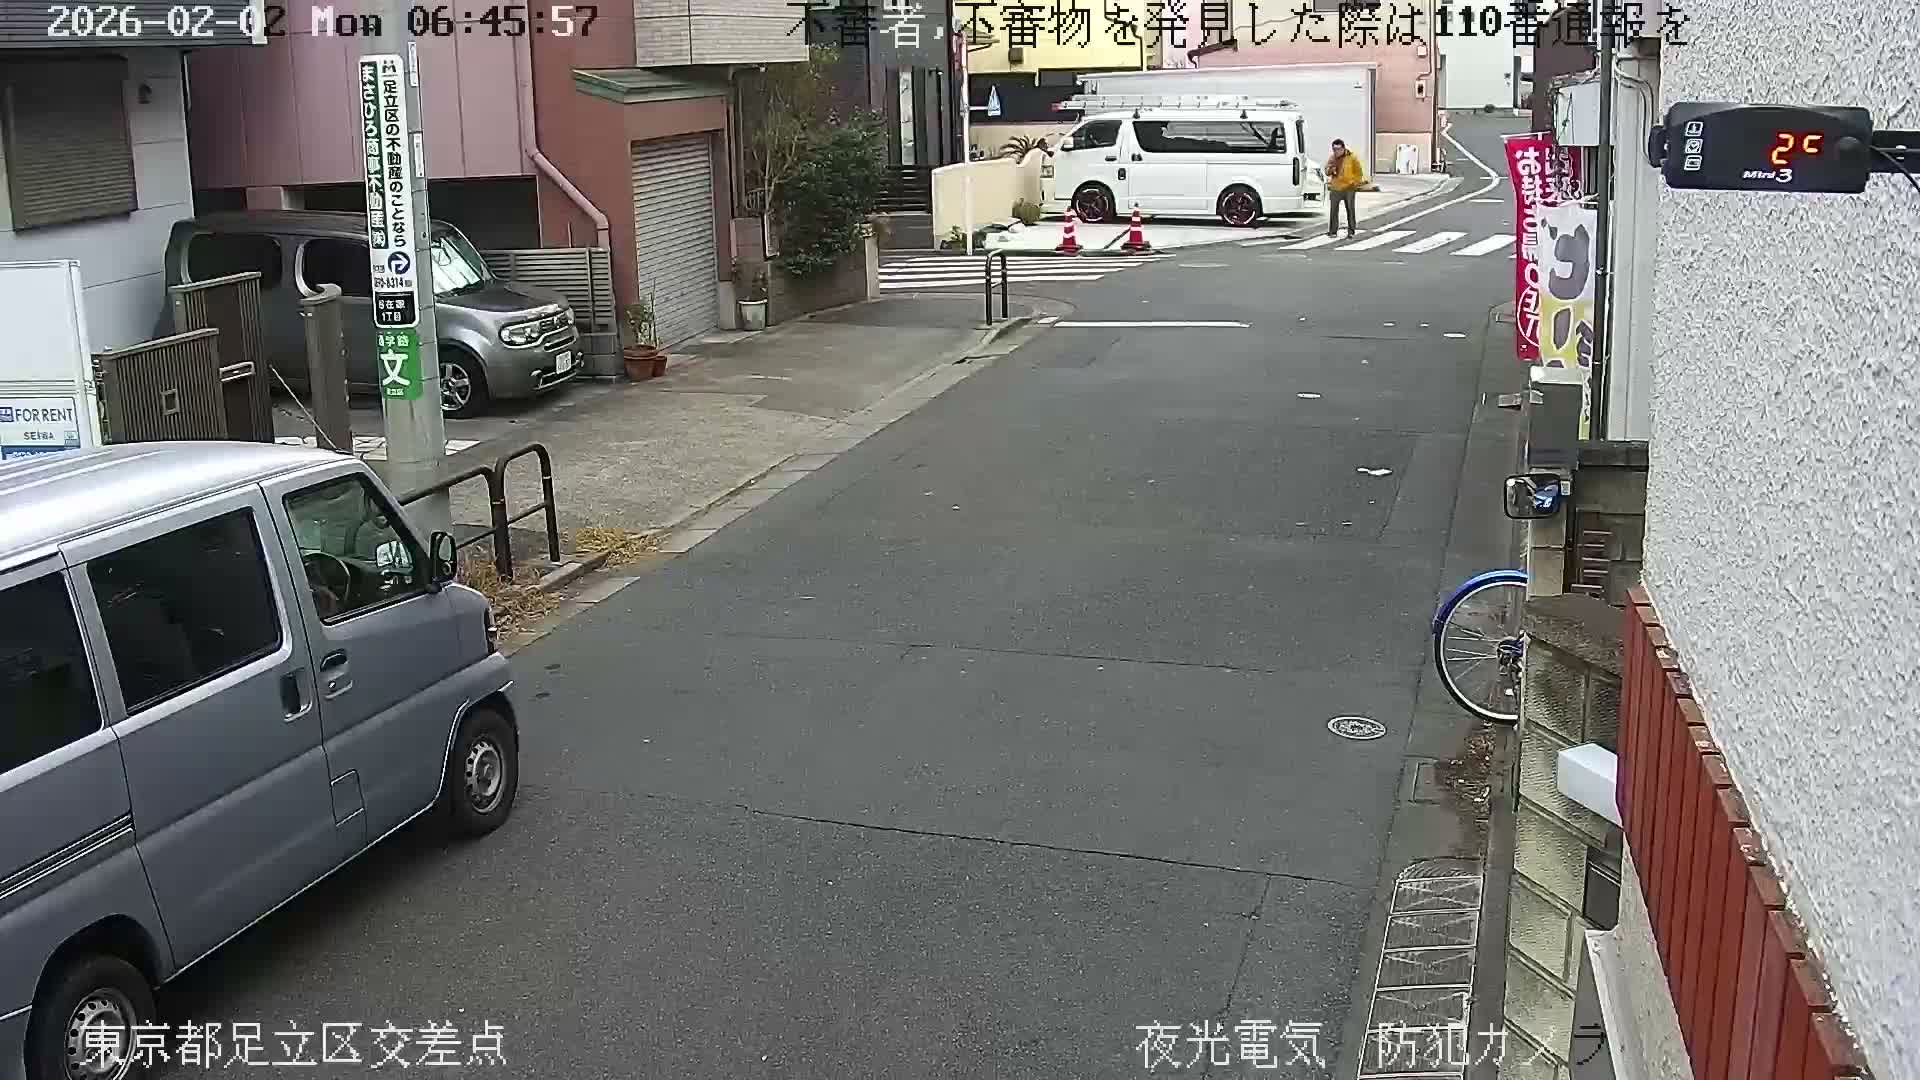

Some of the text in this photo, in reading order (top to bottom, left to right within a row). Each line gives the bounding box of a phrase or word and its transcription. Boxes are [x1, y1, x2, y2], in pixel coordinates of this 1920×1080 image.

[383, 79, 407, 247] 足立区の不動産のことなら
[380, 348, 411, 386] 文
[15, 408, 40, 423] FOR
[41, 408, 73, 422] RENT
